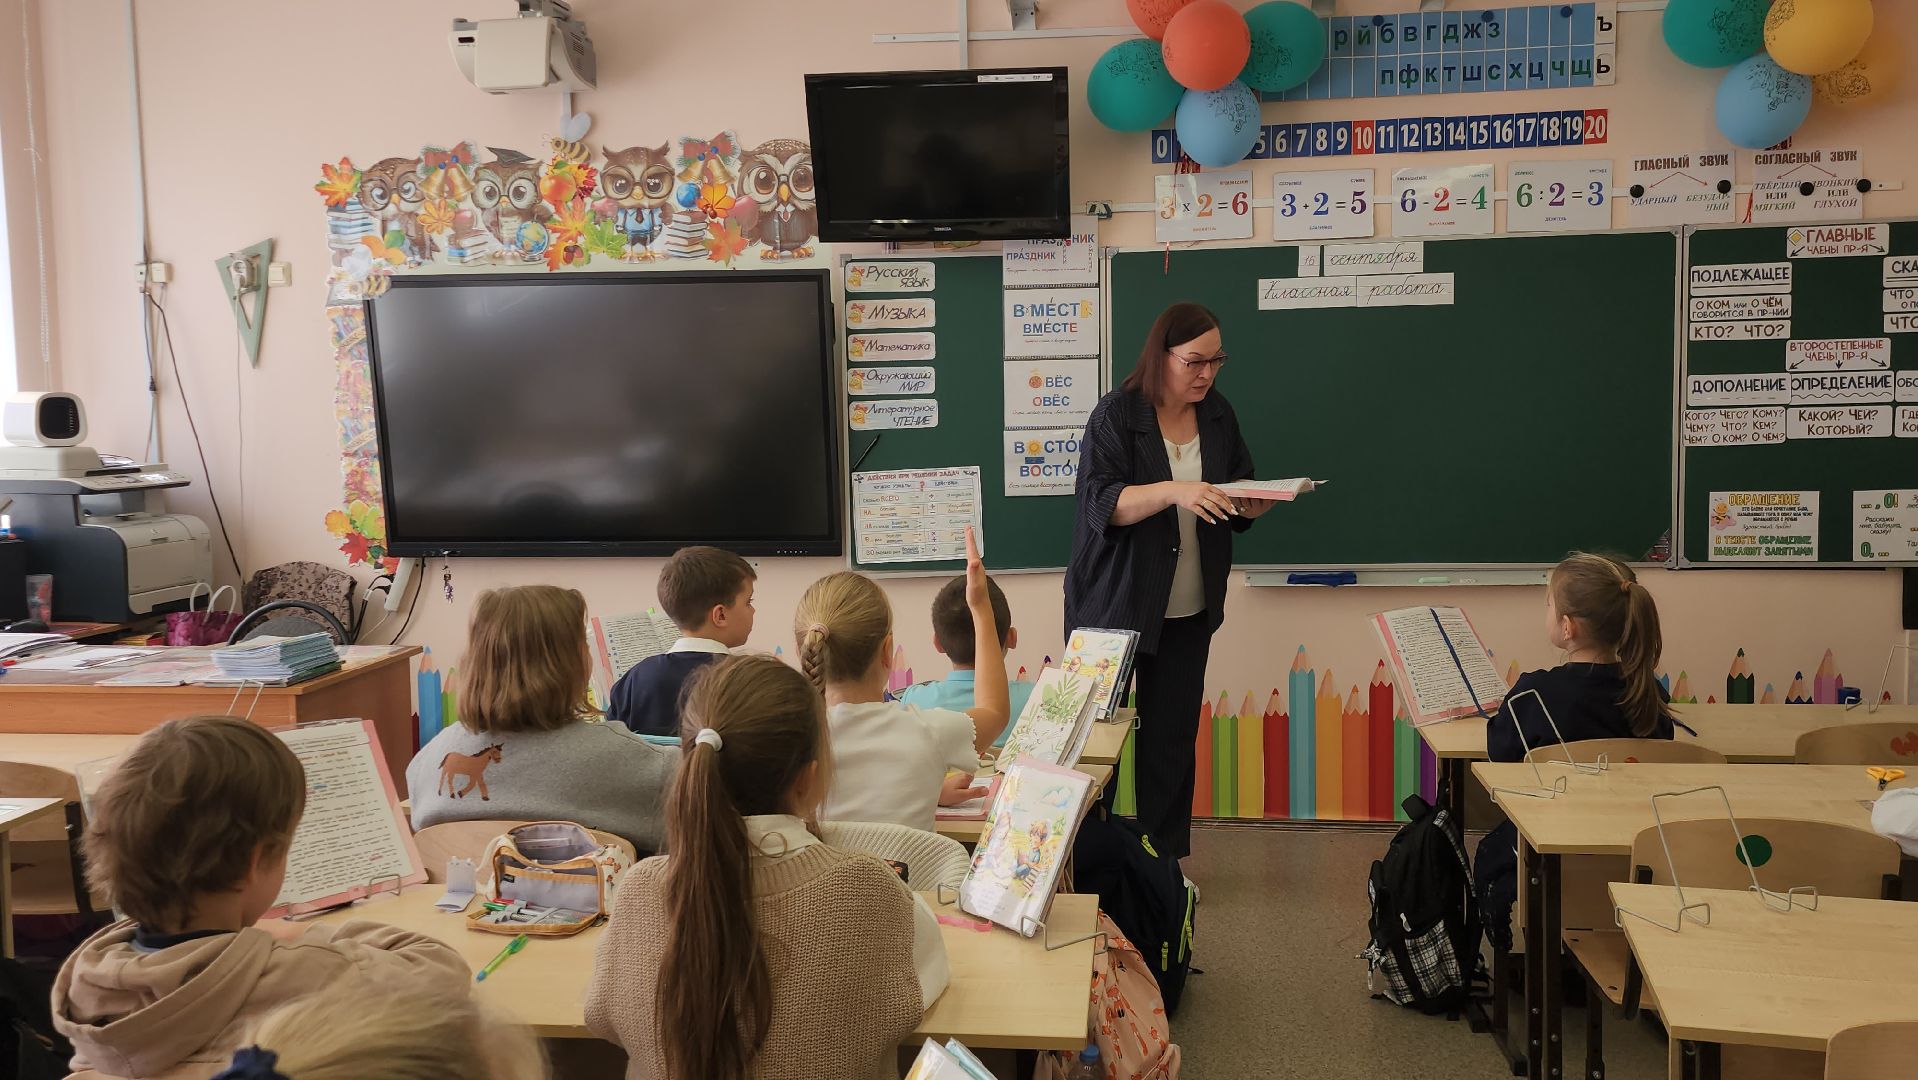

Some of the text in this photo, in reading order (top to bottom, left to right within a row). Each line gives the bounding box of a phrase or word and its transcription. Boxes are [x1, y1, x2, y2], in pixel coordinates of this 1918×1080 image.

[1156, 115, 1607, 159] 0 5 6 7 8 9 10 11 12 13 14 15 16 17 18 19 20
[1634, 153, 1729, 171] ГЛАСНЫЙ ЗВУК
[1754, 150, 1857, 165] СОГЛАСНЫЙ ЗВУК
[1400, 185, 1488, 212] 6 2 4
[1516, 181, 1604, 208] 6 2 3
[1630, 194, 1677, 206] УДАРНЫЙ
[1765, 192, 1788, 200] ИЛИ
[1160, 195, 1176, 219] 3
[1196, 193, 1213, 218] 2
[1231, 191, 1249, 215] 6
[1281, 190, 1367, 217] 3 2 5
[1813, 198, 1858, 209] ГЛУХОЙ
[1806, 226, 1877, 244] ГЛАВНЫЕ
[1304, 243, 1418, 272] 16 сентября
[1807, 245, 1839, 255] ЧЛЕНЫ
[1691, 266, 1790, 284] ПОДЛЕЖАЩЕЕ
[1264, 275, 1444, 305] Классная работа
[1889, 289, 1914, 300] ЧТО
[1706, 300, 1730, 310] КОМ
[1692, 310, 1744, 319] ГОВОРИТСЯ
[1694, 324, 1785, 339] КТО? ЧТО?
[864, 339, 931, 352] Математика
[1789, 339, 1884, 352] ВТОРОСТЕПЕННЫЕ
[1805, 351, 1838, 362] ЧЛЕНЫ
[866, 368, 932, 384] Окружающий
[1791, 374, 1893, 391] ОПРЕДЕЛЕНИЕ
[1691, 377, 1787, 394] ДОПОЛНЕНИЕ
[1728, 493, 1801, 506] ОБРАЩЕНИЕ
